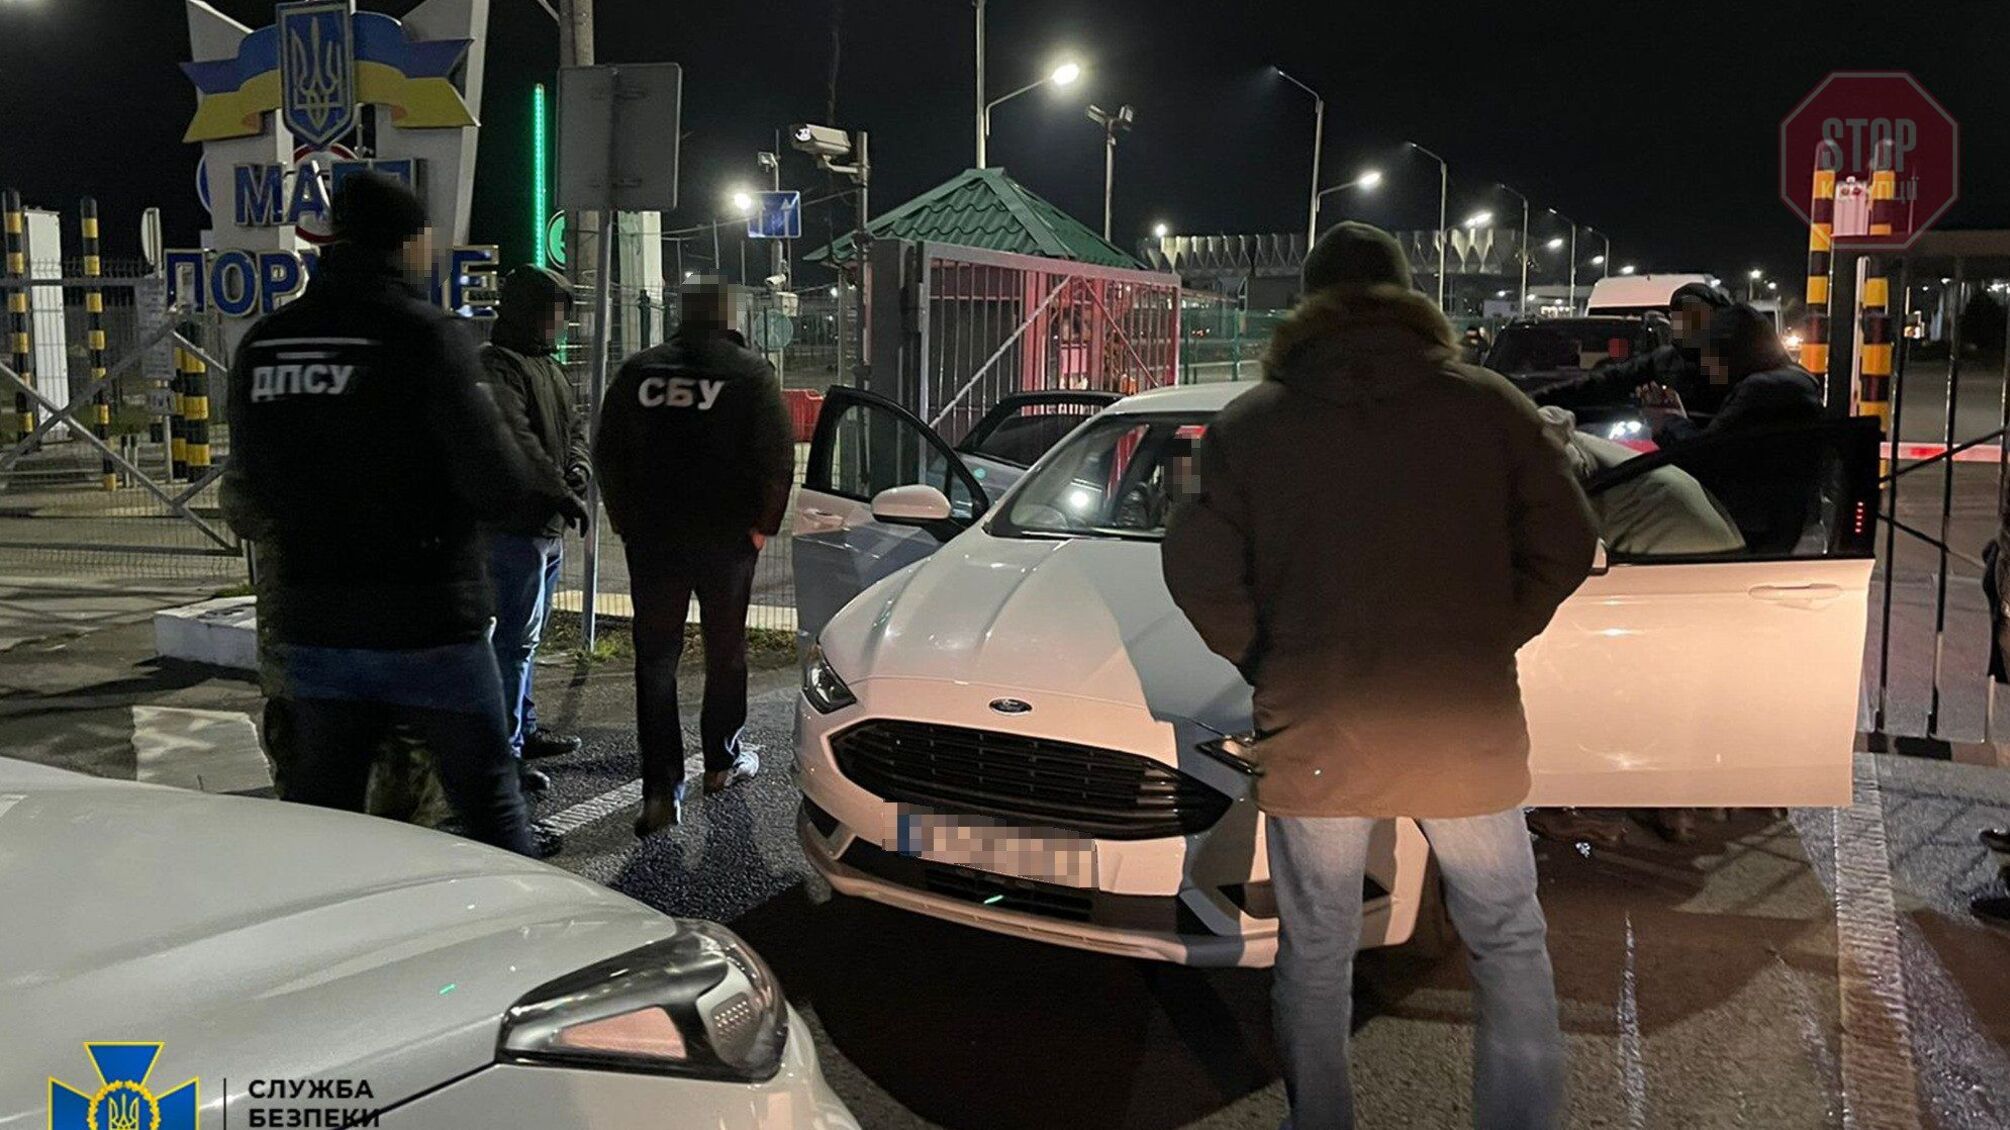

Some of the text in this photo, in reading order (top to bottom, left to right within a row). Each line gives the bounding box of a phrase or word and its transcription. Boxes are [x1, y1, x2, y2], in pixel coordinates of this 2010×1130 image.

[164, 247, 500, 319] ПОРЕ
[251, 364, 354, 403] ДПСУ
[638, 377, 725, 410] СБУ
